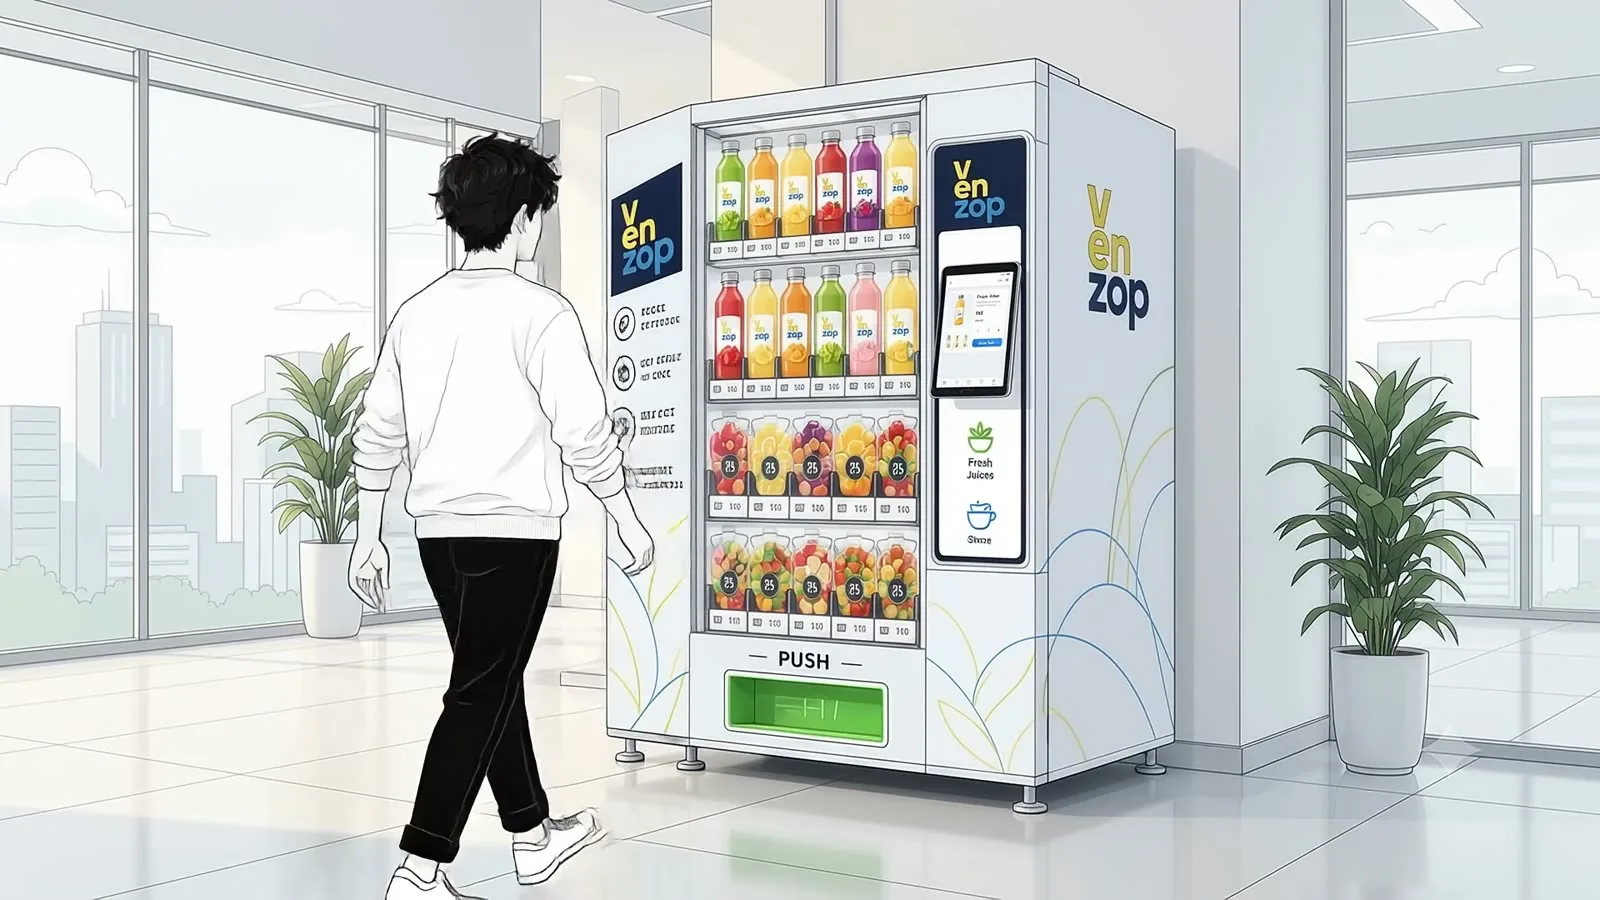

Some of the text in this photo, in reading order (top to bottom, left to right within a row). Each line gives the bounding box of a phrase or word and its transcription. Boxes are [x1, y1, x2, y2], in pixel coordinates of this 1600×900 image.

[954, 178, 989, 199] en
[954, 196, 1005, 224] zop
[621, 218, 656, 250] en
[622, 237, 675, 276] zop
[1088, 229, 1131, 276] en
[1088, 271, 1149, 331] zop
[857, 329, 873, 338] zop
[892, 328, 910, 336] zop
[968, 457, 993, 468] Fresh
[966, 471, 995, 480] Juices
[779, 651, 829, 670] PUSH
